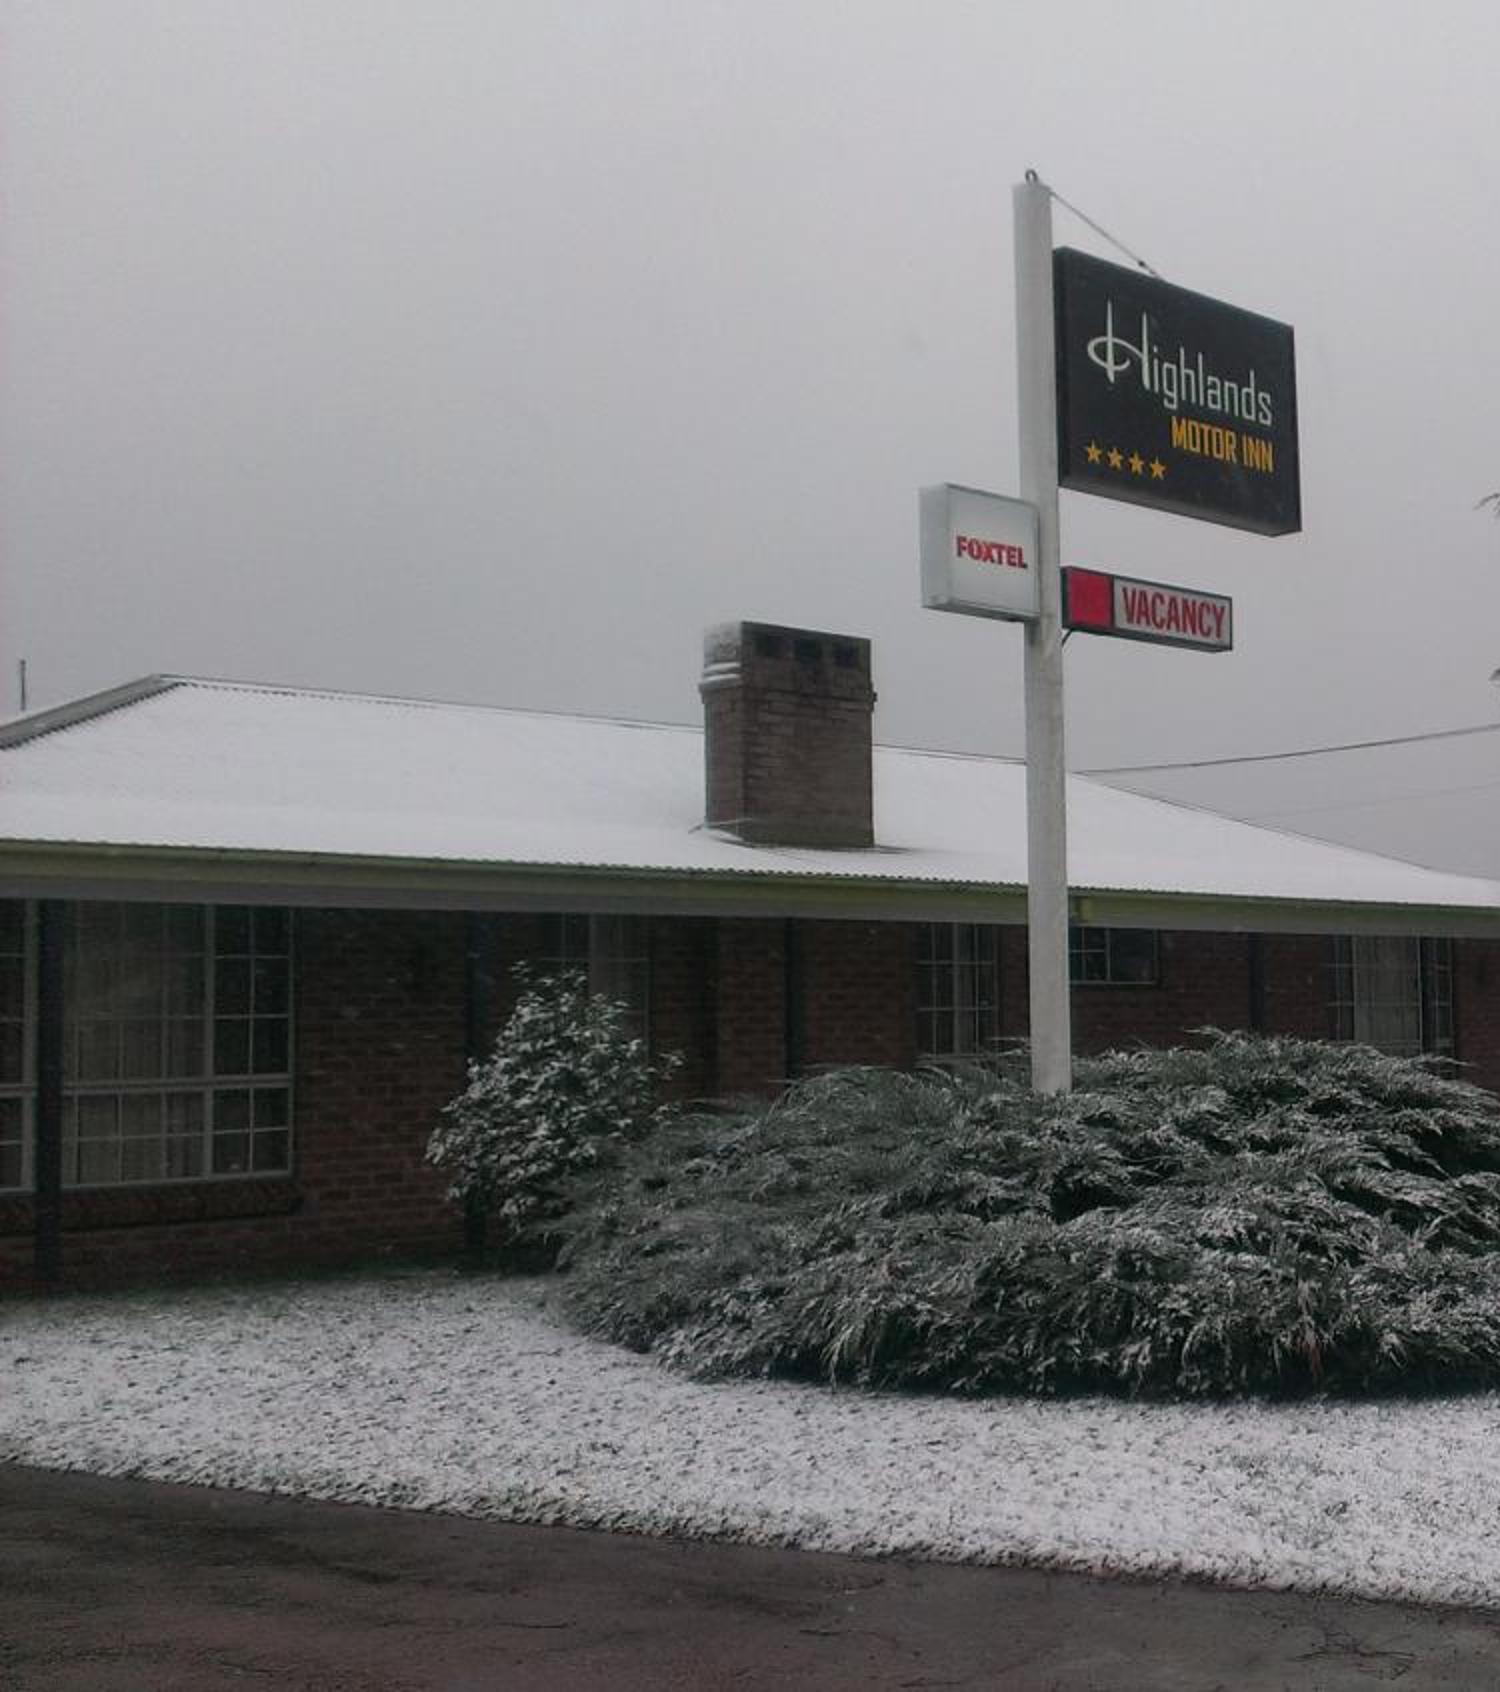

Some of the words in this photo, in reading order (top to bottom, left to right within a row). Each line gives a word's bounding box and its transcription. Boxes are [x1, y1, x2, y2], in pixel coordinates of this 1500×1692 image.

[1087, 299, 1273, 426] Highlands
[1171, 416, 1237, 464] MOTOR
[1242, 435, 1275, 473] INN
[956, 536, 1028, 569] FOXTEL
[1122, 587, 1226, 640] VACANCY
